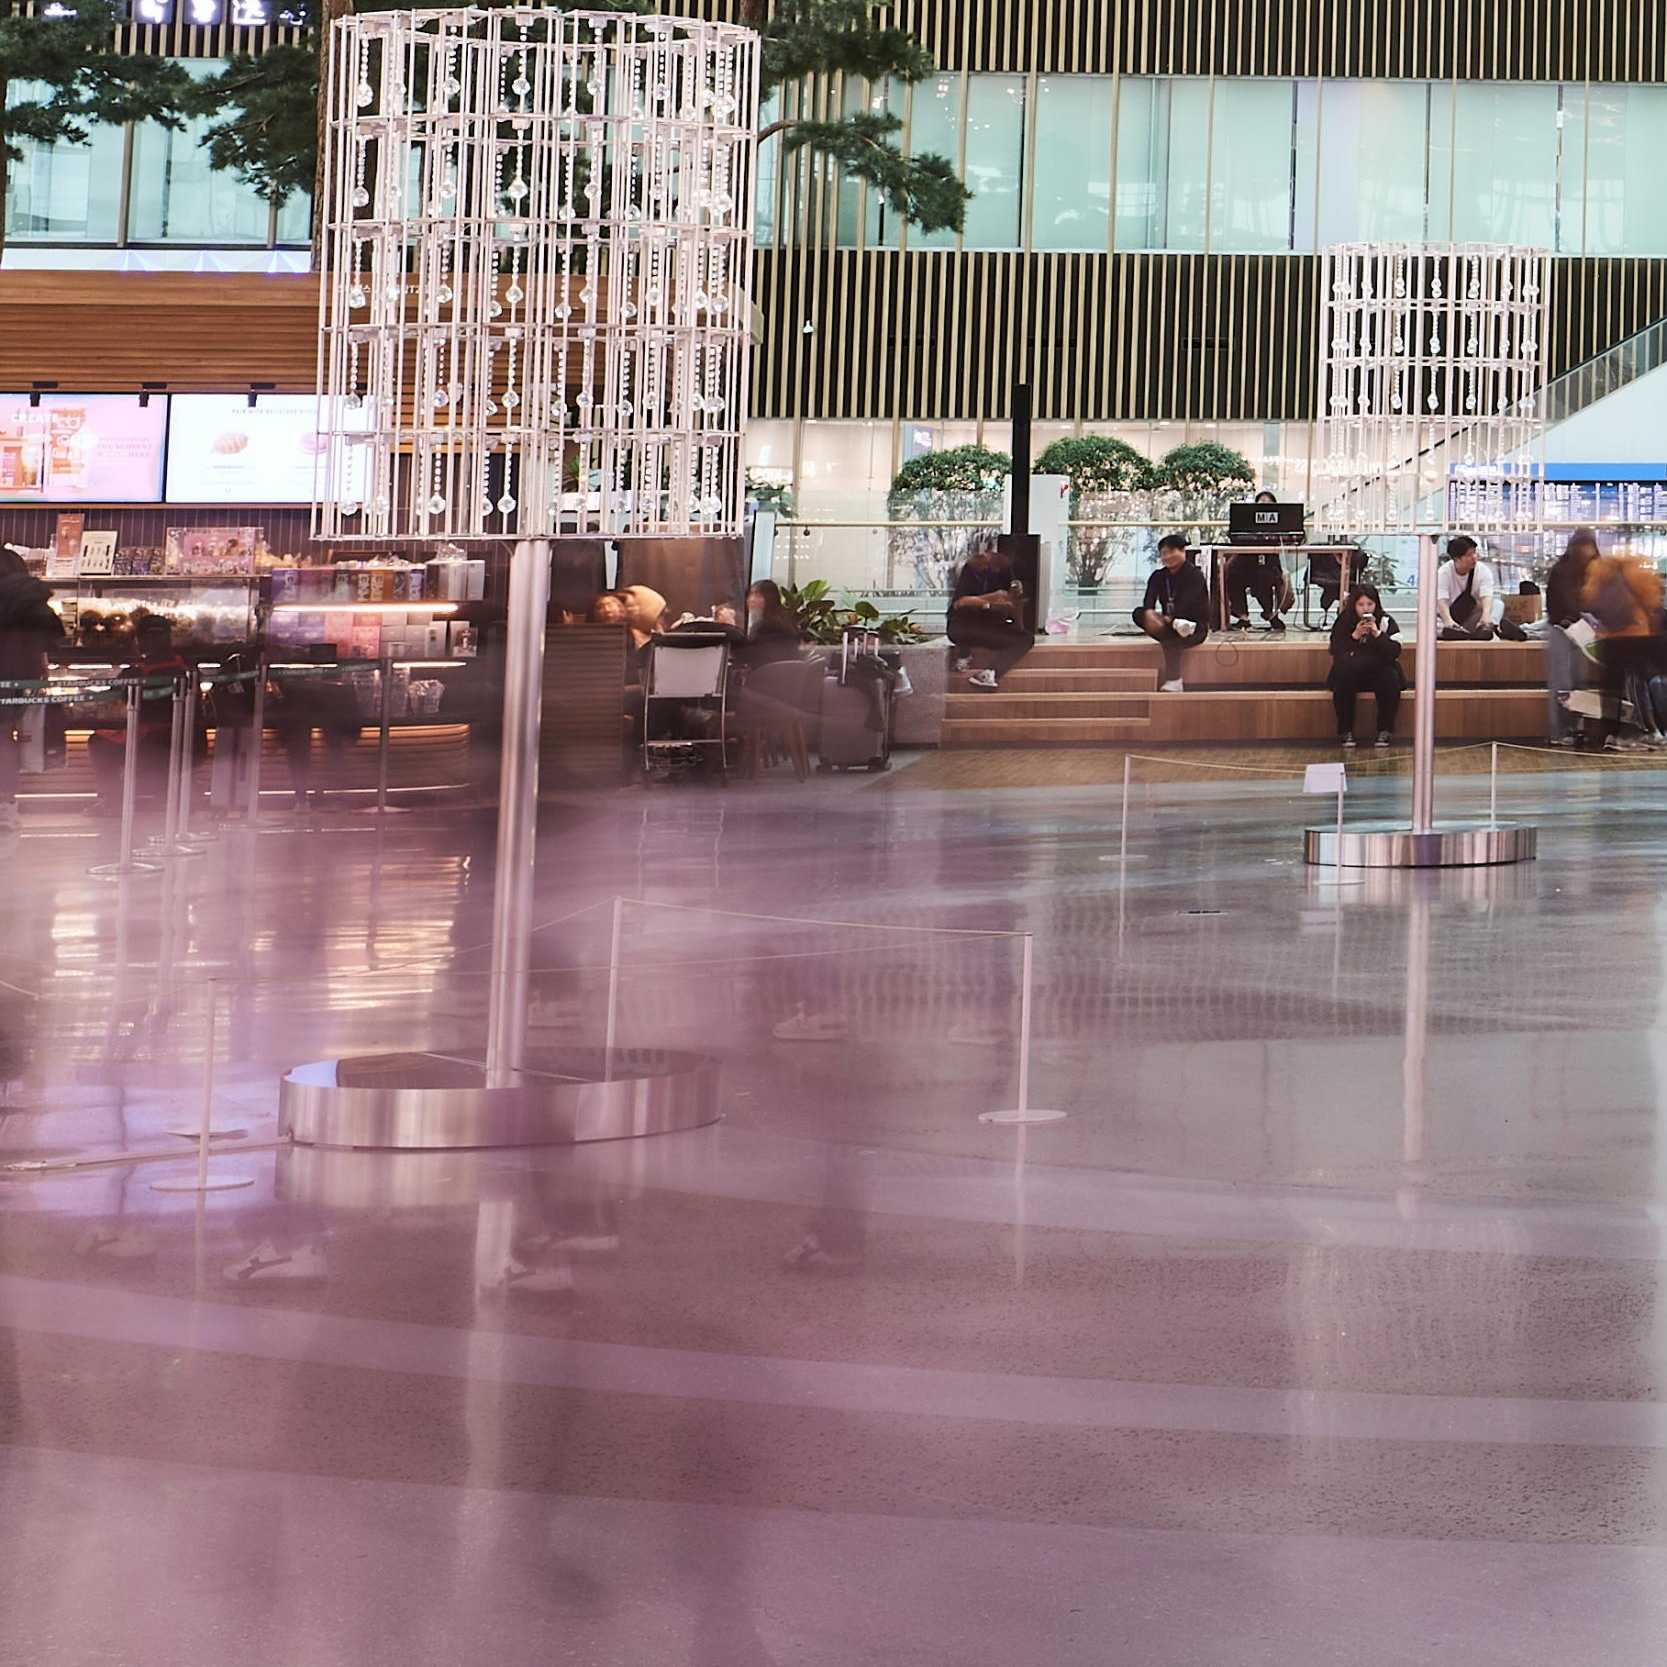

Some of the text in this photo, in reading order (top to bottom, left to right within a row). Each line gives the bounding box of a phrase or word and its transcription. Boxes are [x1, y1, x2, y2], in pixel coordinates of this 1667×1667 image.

[108, 677, 138, 686] COFFEE
[0, 694, 86, 705] TARBUCKS COFFEE
